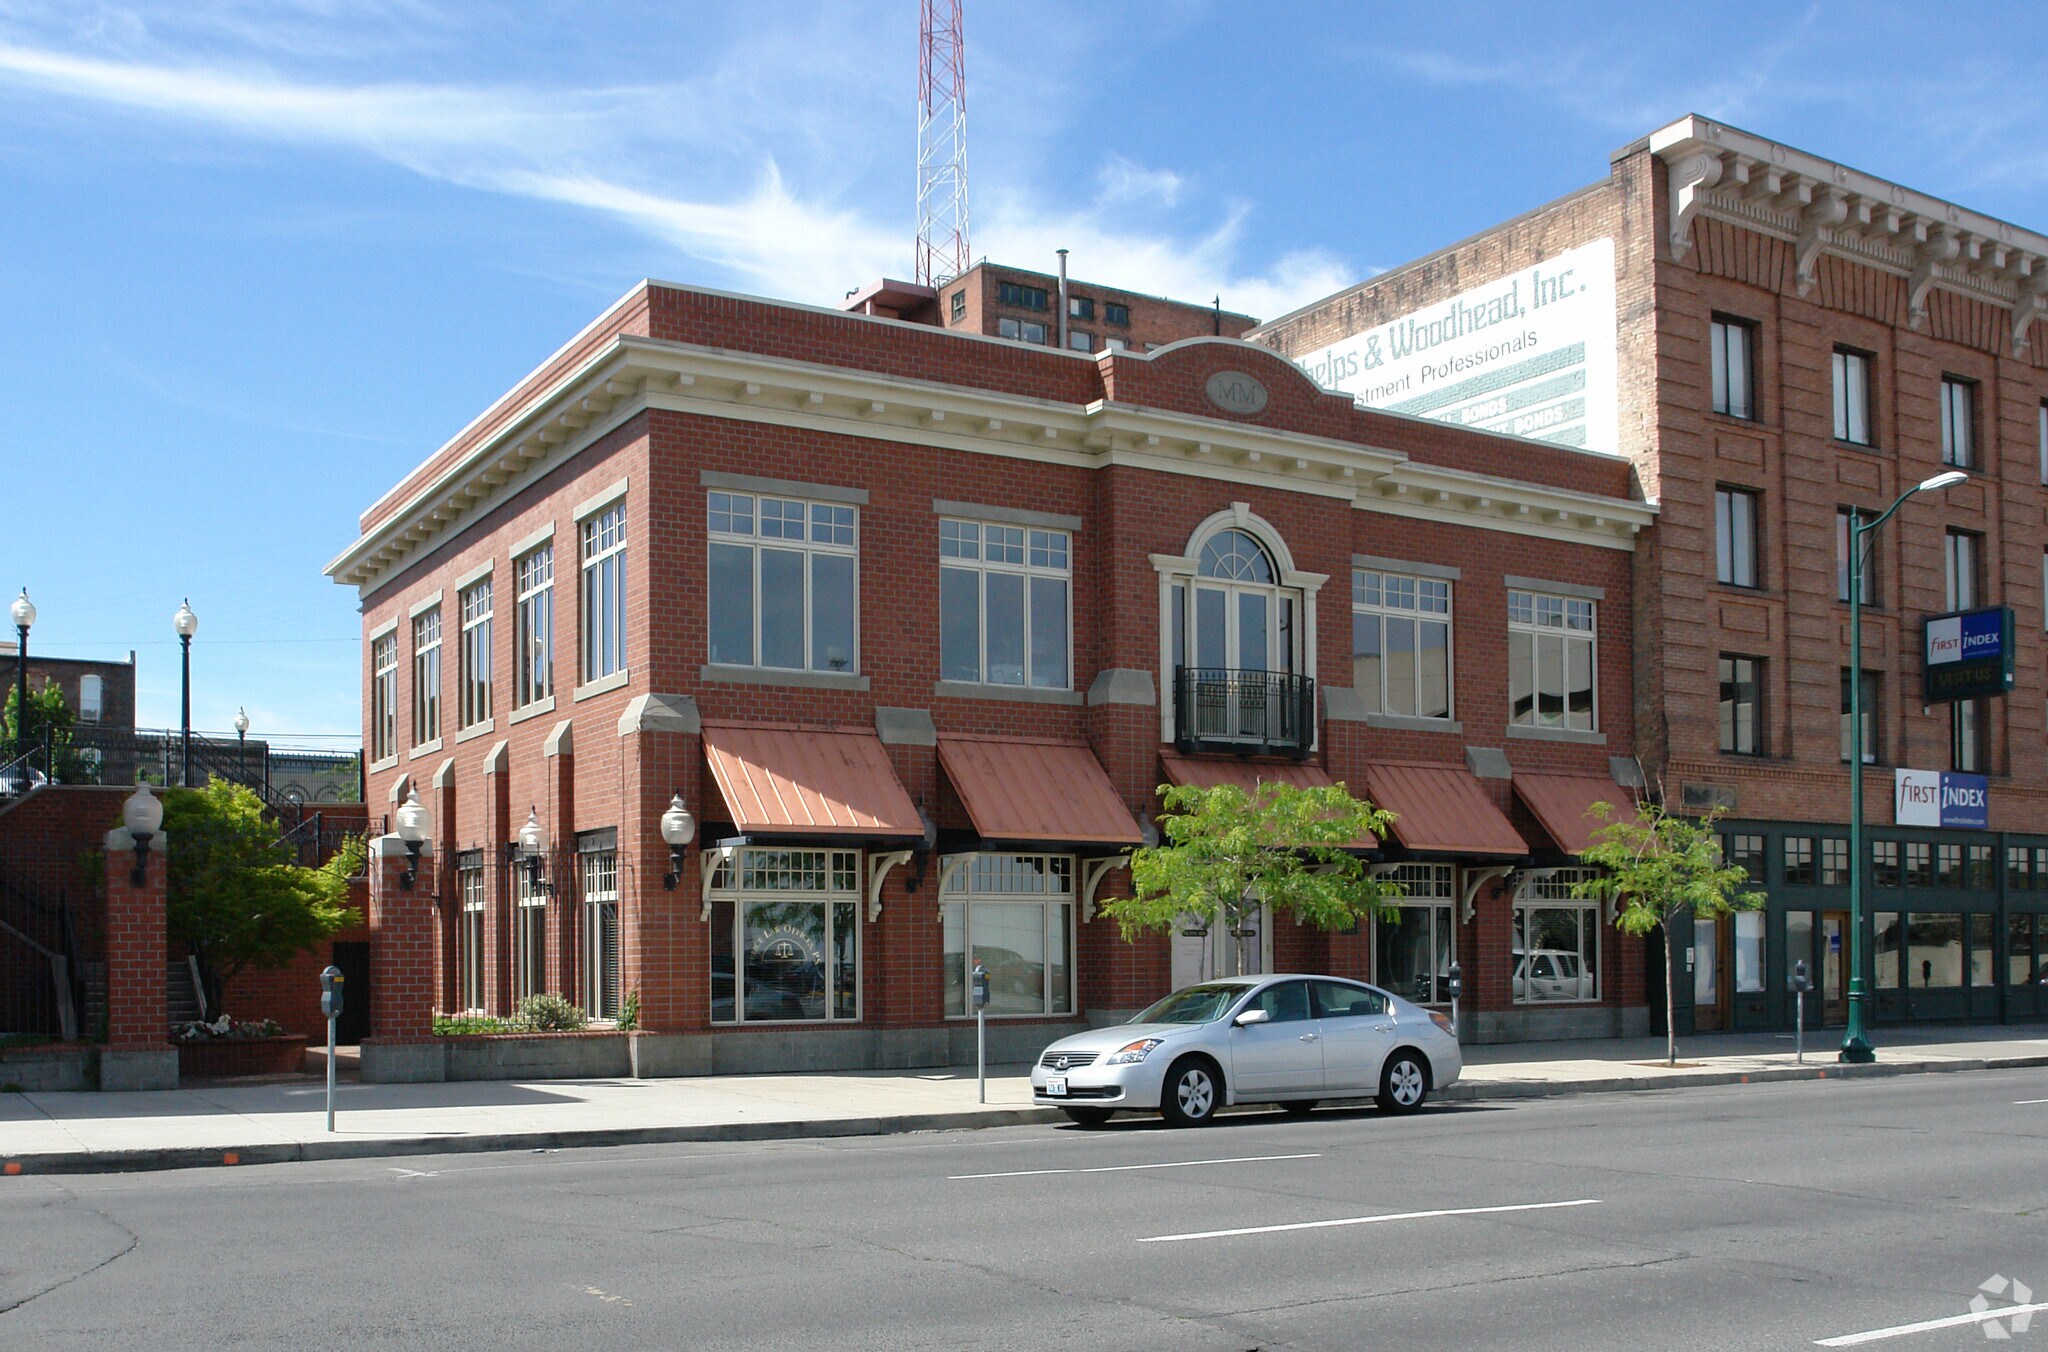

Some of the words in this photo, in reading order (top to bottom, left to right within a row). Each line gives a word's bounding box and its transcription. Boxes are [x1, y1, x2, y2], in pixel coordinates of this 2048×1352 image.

[1301, 350, 1358, 391] helps
[1365, 334, 1384, 370] &
[1389, 279, 1526, 360] Woodhead,
[1533, 269, 1586, 310] Inc.
[1218, 379, 1256, 405] MM
[1356, 374, 1410, 405] stment
[1421, 330, 1538, 384] Professionals
[1513, 405, 1564, 435] BONDS
